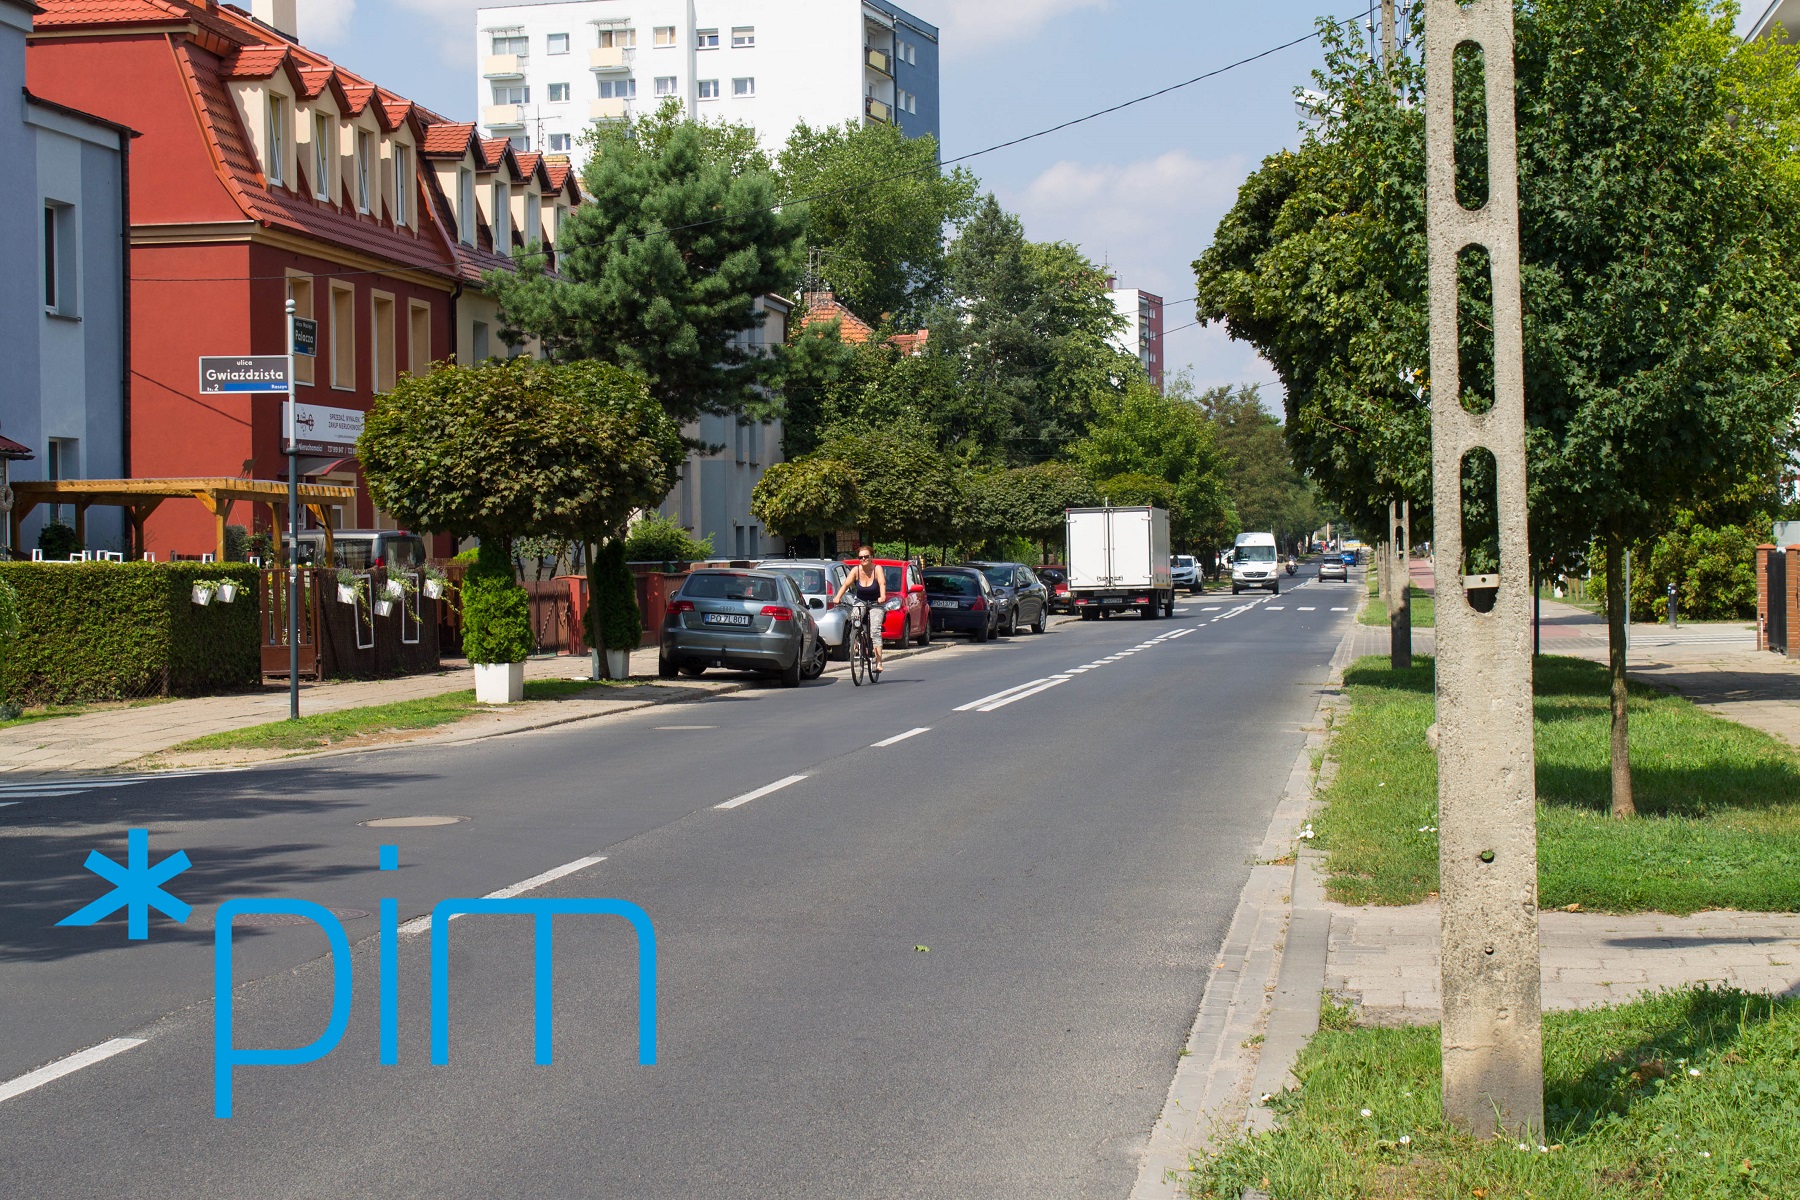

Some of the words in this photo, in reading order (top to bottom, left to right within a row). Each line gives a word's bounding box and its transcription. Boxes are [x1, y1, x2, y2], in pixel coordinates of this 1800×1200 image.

[206, 368, 284, 381] Gwiaździsta
[710, 614, 722, 623] PO
[723, 615, 746, 624] 7L801
